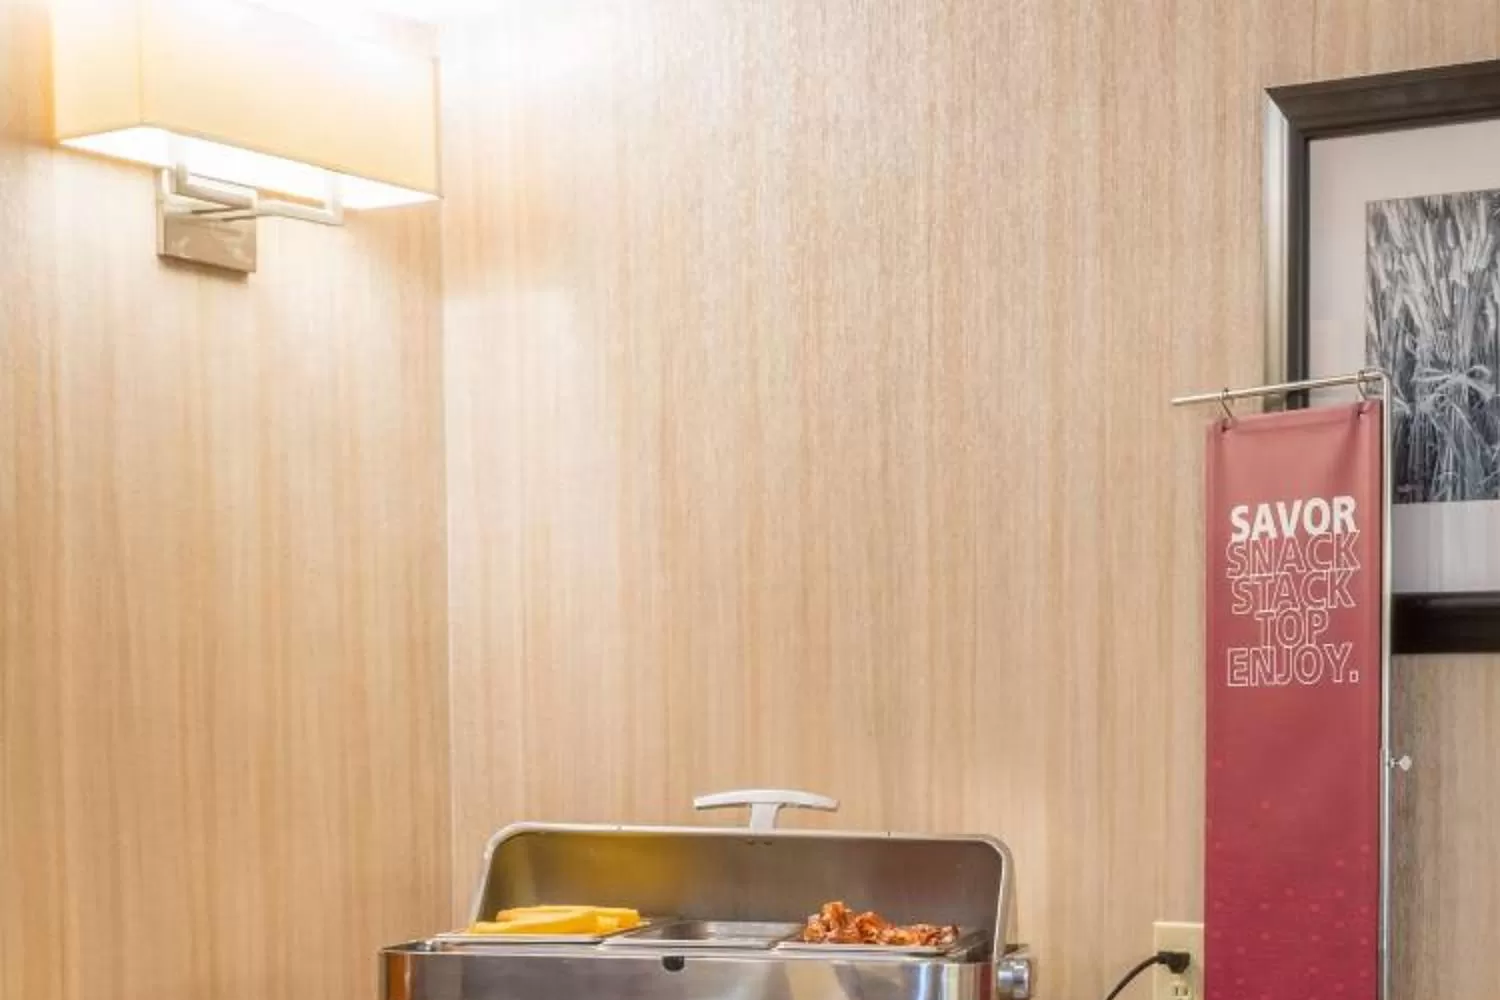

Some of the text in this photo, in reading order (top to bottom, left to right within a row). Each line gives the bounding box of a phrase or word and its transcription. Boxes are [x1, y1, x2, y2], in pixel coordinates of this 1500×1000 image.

[1230, 495, 1358, 542] SAVOR
[1225, 530, 1361, 578] SNACK
[1231, 568, 1357, 614] STACK
[1254, 602, 1330, 648] TOP
[1226, 643, 1360, 687] ENJOY.
